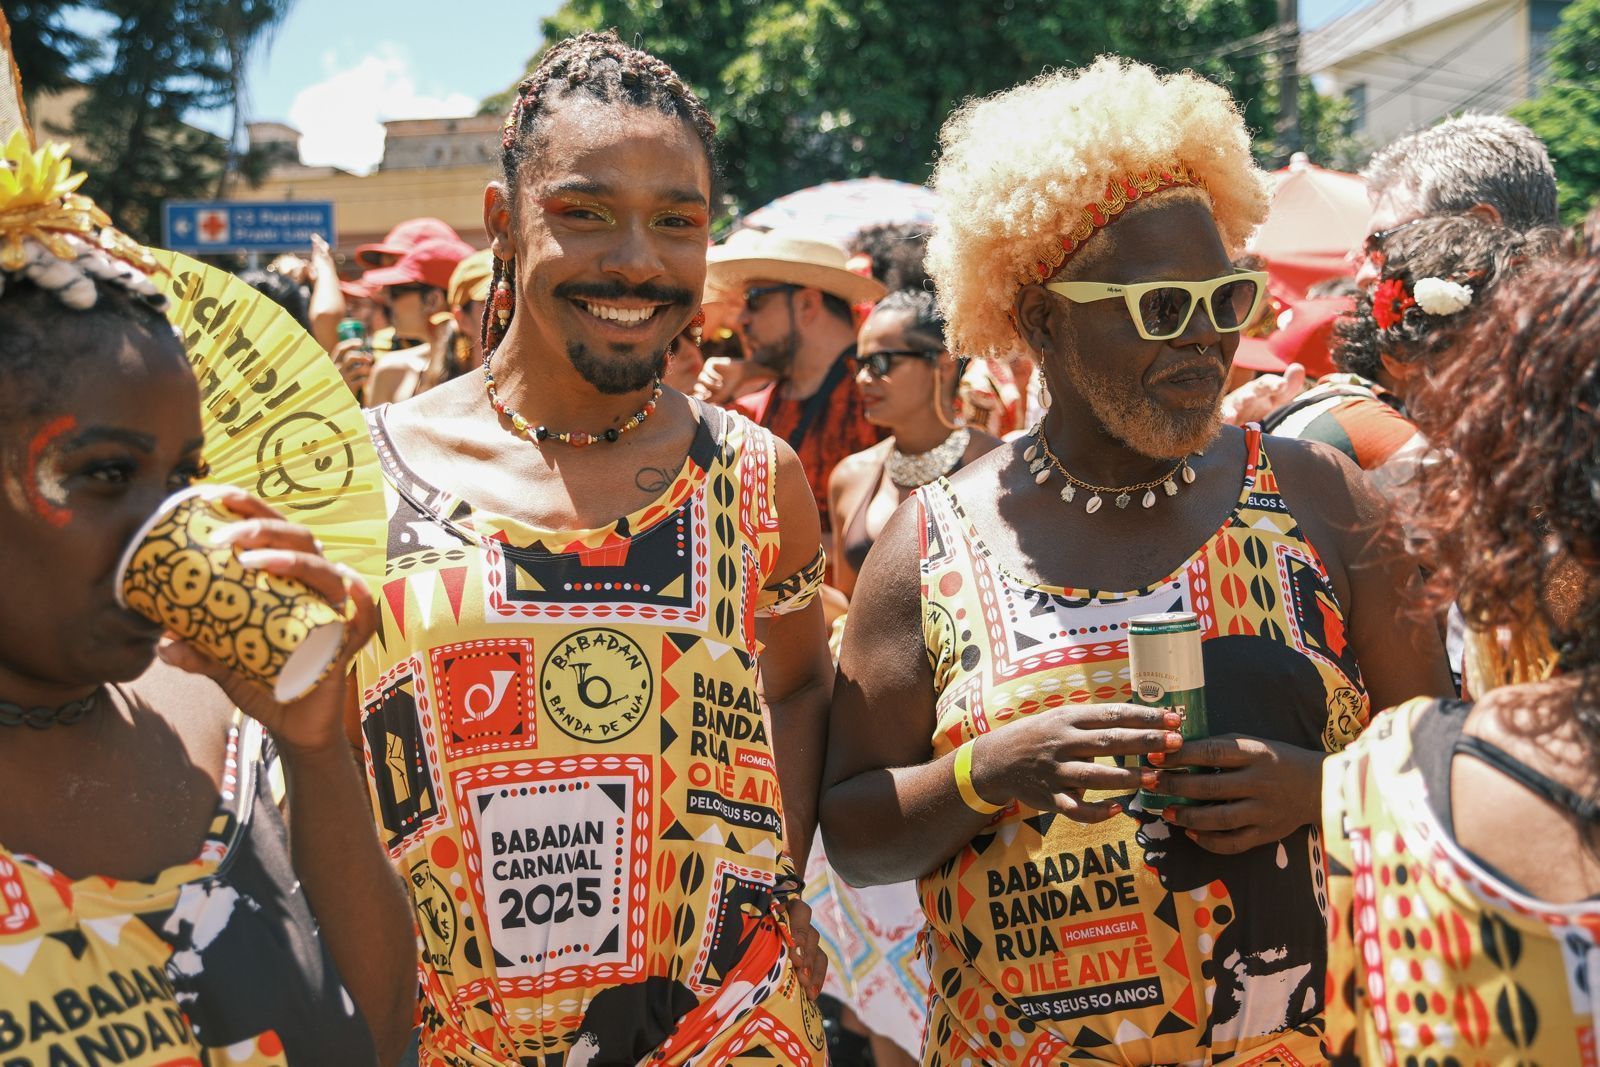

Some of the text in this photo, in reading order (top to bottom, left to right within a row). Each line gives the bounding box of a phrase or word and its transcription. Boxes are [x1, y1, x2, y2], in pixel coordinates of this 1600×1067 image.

[1247, 496, 1277, 508] ELOS
[551, 632, 643, 671] BABADAN
[693, 672, 762, 715] BABAD
[549, 694, 643, 736] BANDA DE RUA
[692, 701, 769, 746] BANDA
[691, 730, 776, 771] RUA HOMEN
[687, 762, 711, 787] O
[742, 809, 762, 823] 50
[491, 820, 604, 856] BABADAN
[492, 849, 603, 881] CARNAVAL
[986, 840, 1131, 898] BABADAN
[498, 877, 602, 930] 2025
[989, 874, 1139, 930] BANDA DE
[995, 920, 1139, 962] RUA HOMENAGEIA
[1001, 935, 1158, 995] O ILÊ AIYÊ
[1020, 985, 1158, 1016] ELOS SEUS 50 ANOS
